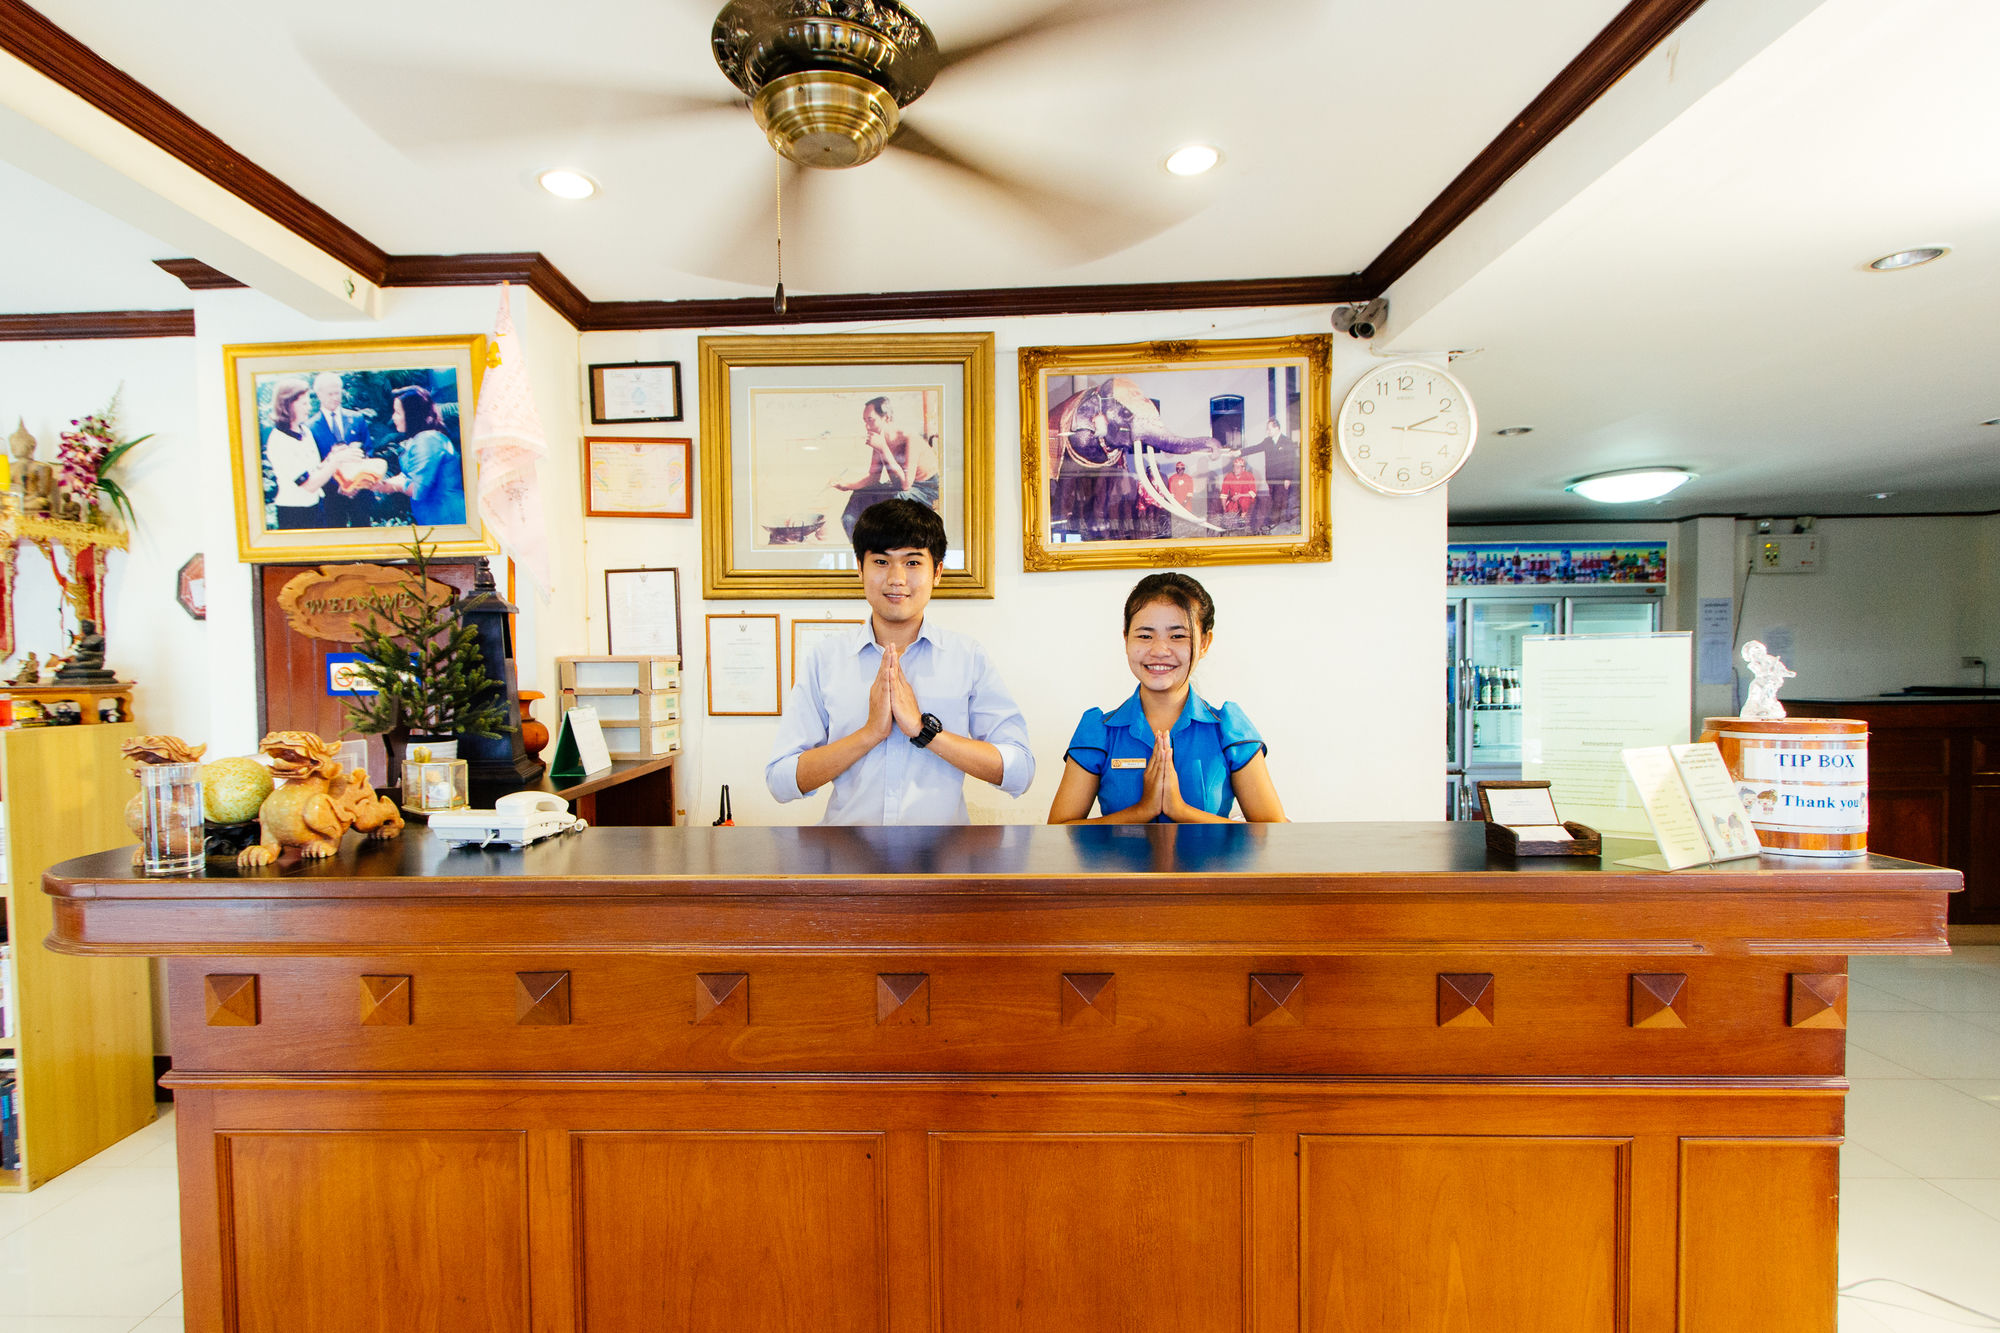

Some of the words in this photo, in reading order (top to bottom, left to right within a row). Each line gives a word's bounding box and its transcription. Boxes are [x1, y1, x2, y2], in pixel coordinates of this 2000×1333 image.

[1376, 381, 1389, 396] 11
[1397, 375, 1414, 391] 12
[1357, 400, 1375, 415] 10
[1439, 398, 1452, 413] 2
[1351, 422, 1365, 437] 9
[1446, 421, 1458, 435] 3
[1358, 445, 1371, 459] 8
[1437, 444, 1450, 458] 4
[1376, 462, 1388, 477] 7
[1397, 467, 1410, 482] 6
[1420, 461, 1433, 476] 5
[304, 593, 416, 615] WELCOME
[1774, 753, 1812, 768] TIP
[1818, 754, 1855, 768] BOX
[1781, 794, 1836, 809] Thank
[1839, 798, 1859, 812] you
